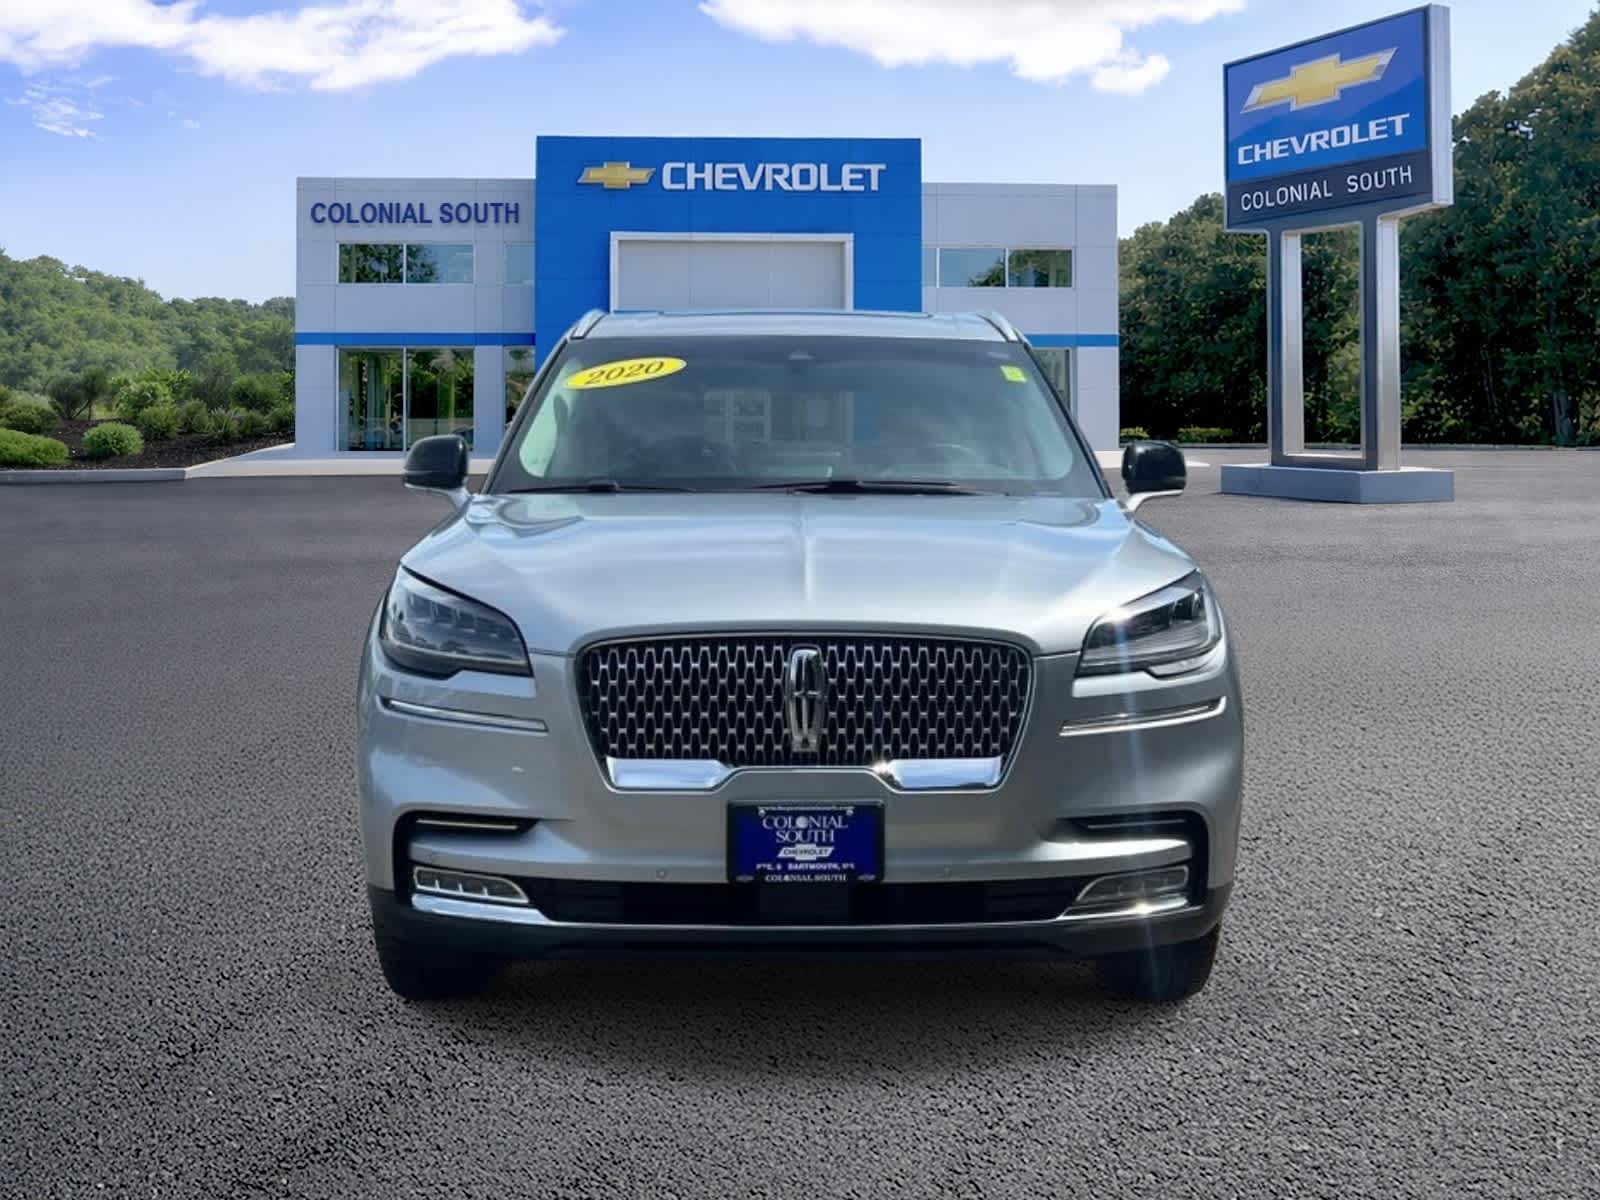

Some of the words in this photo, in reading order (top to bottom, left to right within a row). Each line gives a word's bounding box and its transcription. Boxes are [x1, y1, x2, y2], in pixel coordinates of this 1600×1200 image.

[1237, 113, 1410, 165] CHEVROLET
[661, 162, 887, 192] CHEVROLET
[1240, 180, 1333, 211] COLONIAL
[1346, 165, 1412, 193] SOUTH
[310, 201, 433, 225] COLONIAL
[438, 201, 521, 225] SOUTH
[584, 361, 665, 386] 2020
[762, 816, 848, 829] COLONIAL
[776, 830, 834, 843] SOUTH
